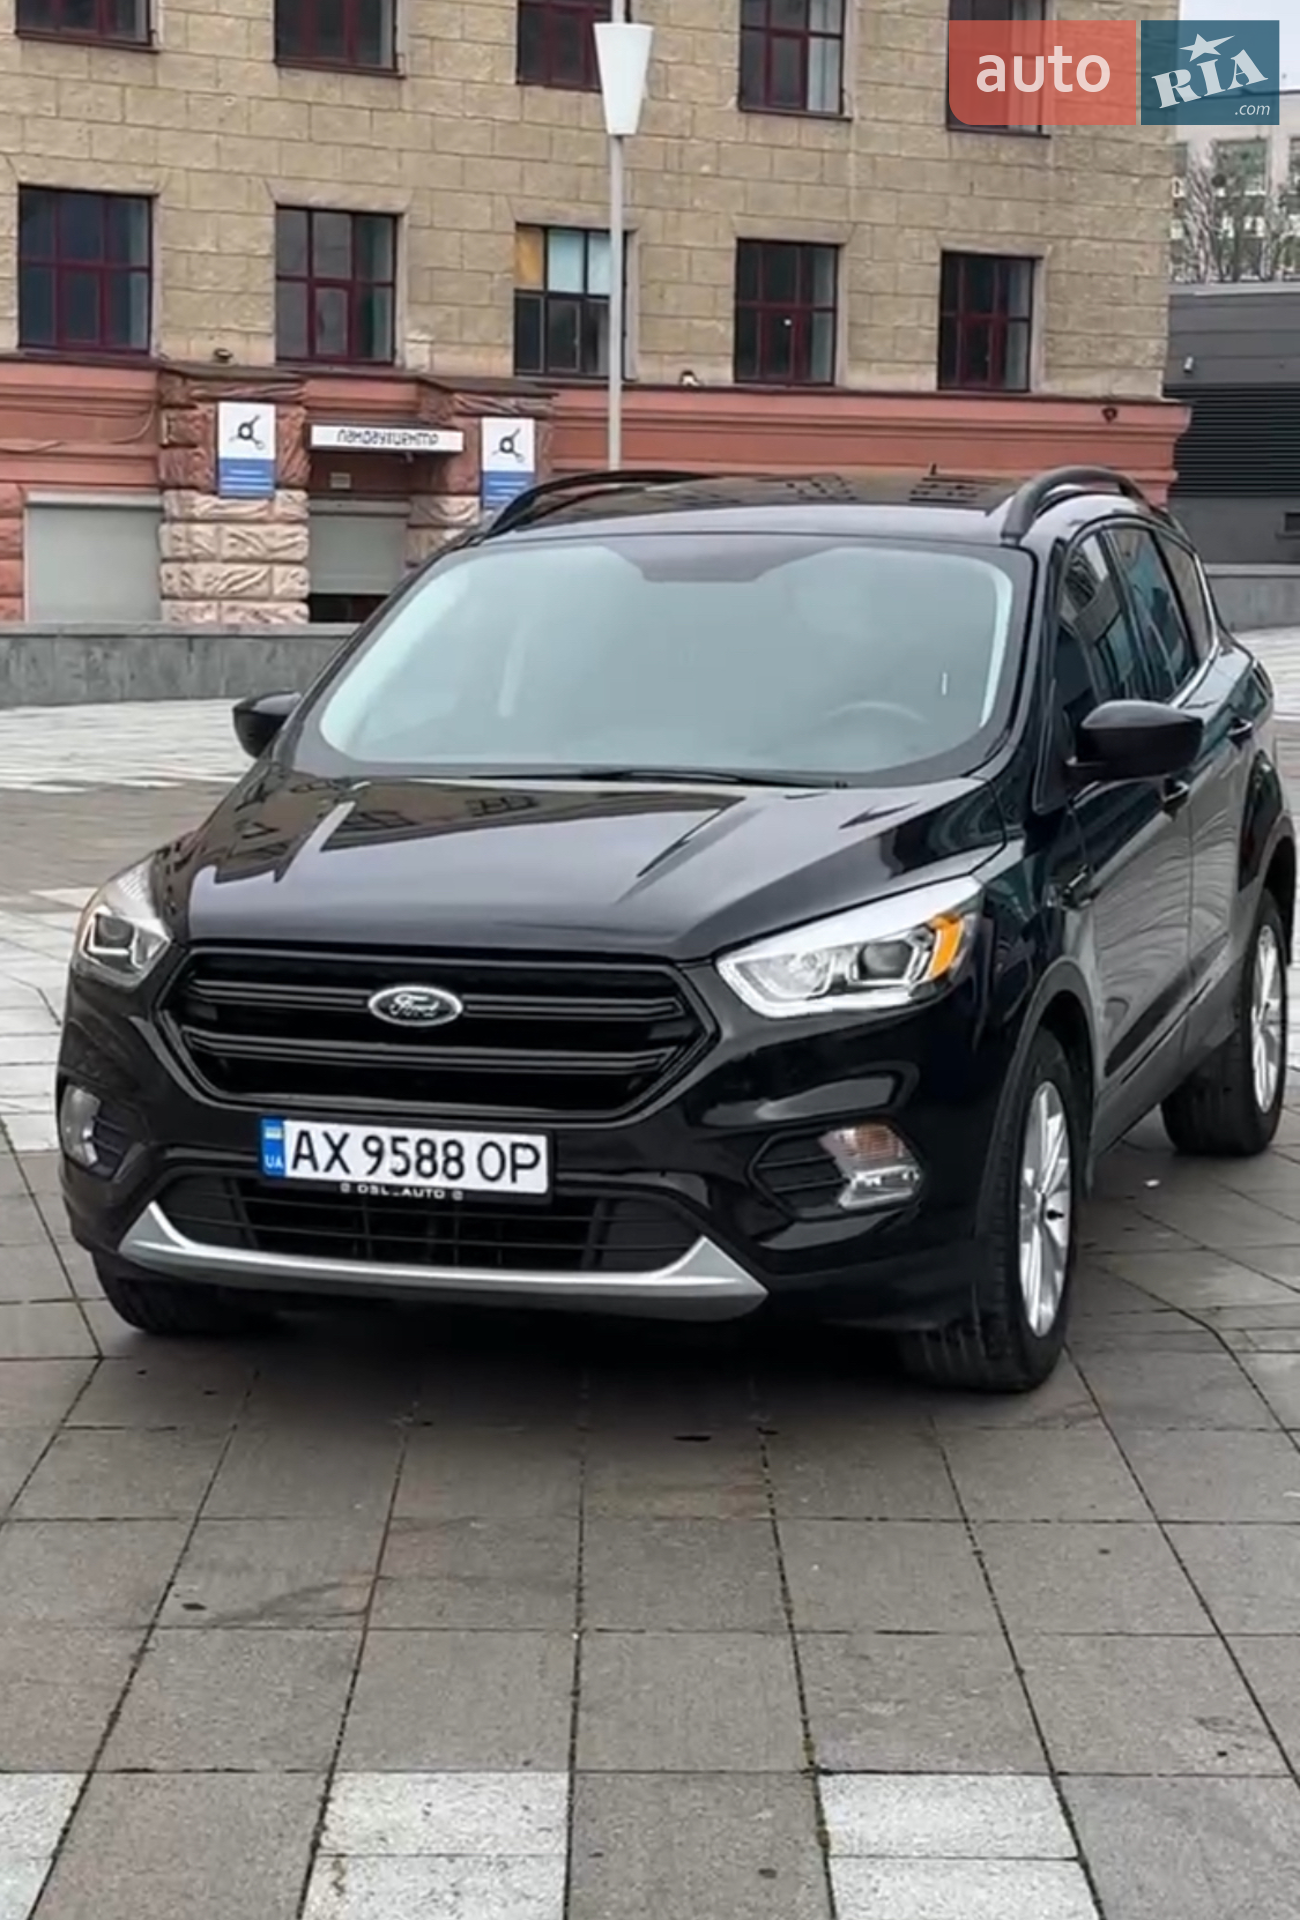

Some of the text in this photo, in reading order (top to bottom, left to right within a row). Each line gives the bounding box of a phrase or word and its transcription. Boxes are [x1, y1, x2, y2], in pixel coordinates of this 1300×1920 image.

[388, 992, 440, 1018] Ford
[264, 1154, 283, 1169] UA
[291, 1129, 541, 1184] AX 9588 OP
